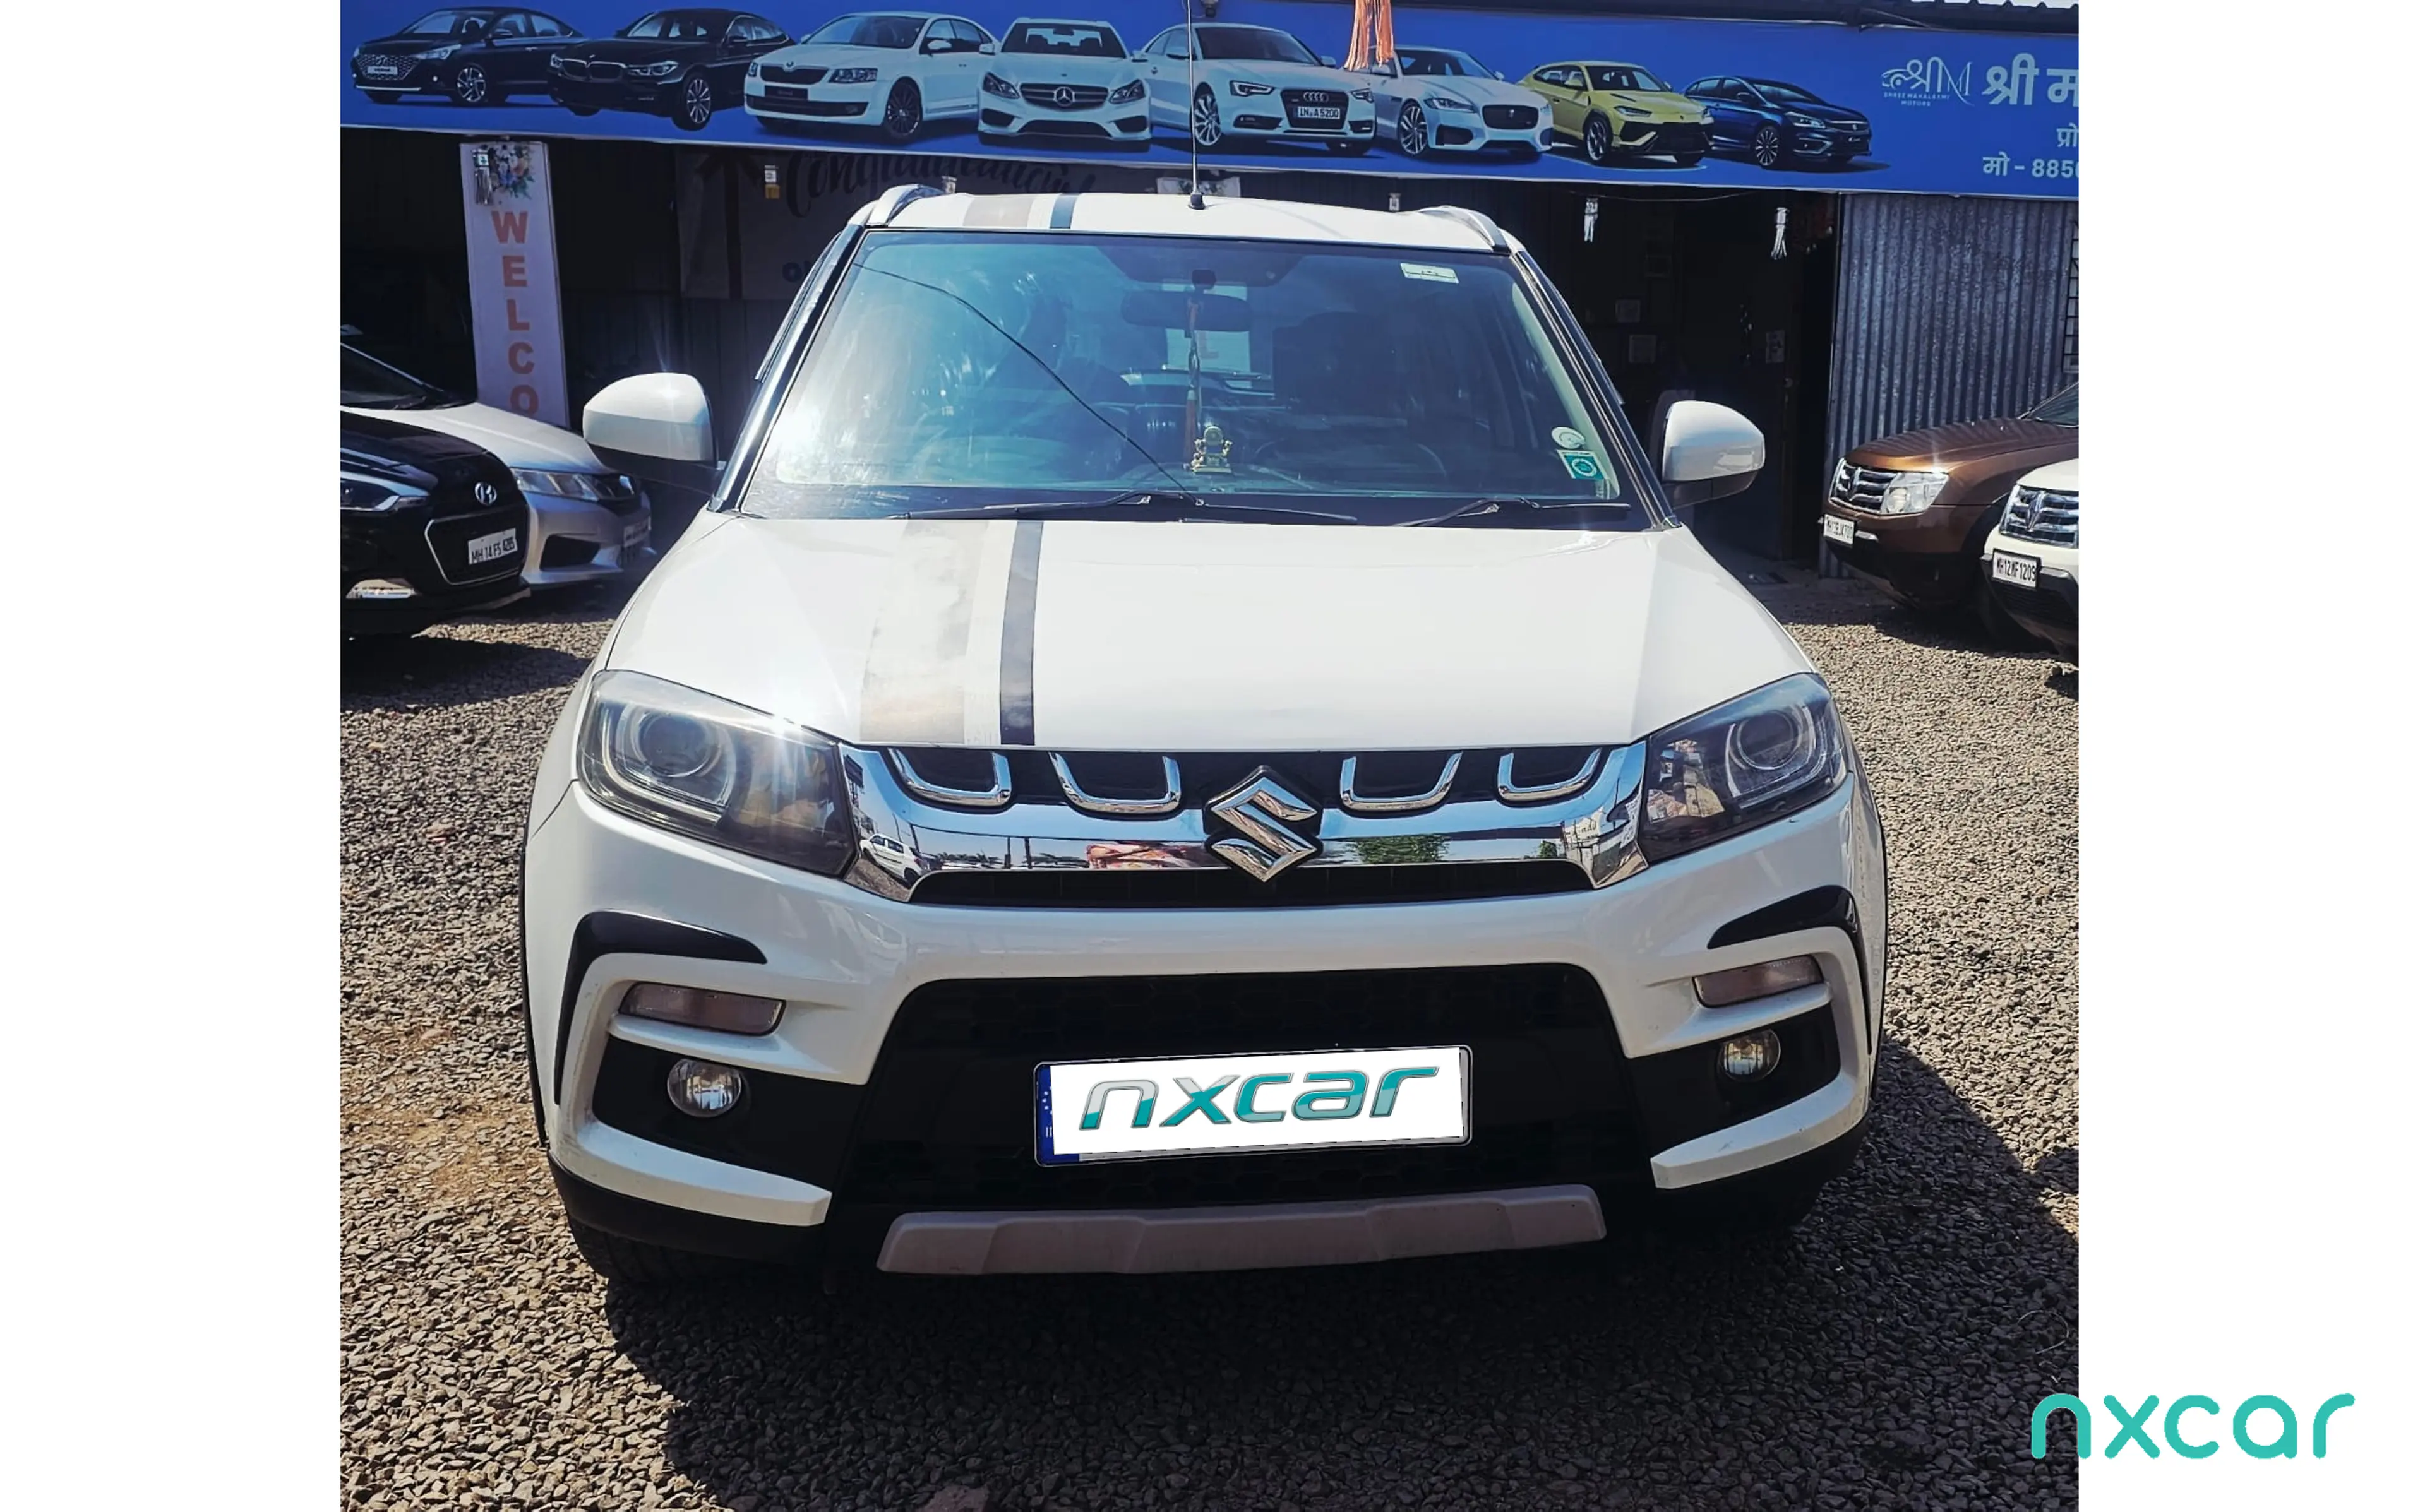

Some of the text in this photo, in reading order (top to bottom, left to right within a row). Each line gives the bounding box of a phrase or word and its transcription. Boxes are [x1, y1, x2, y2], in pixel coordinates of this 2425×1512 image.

[1982, 52, 2039, 105] श्री
[1982, 151, 2010, 177] मो
[2032, 158, 2079, 179] 885
